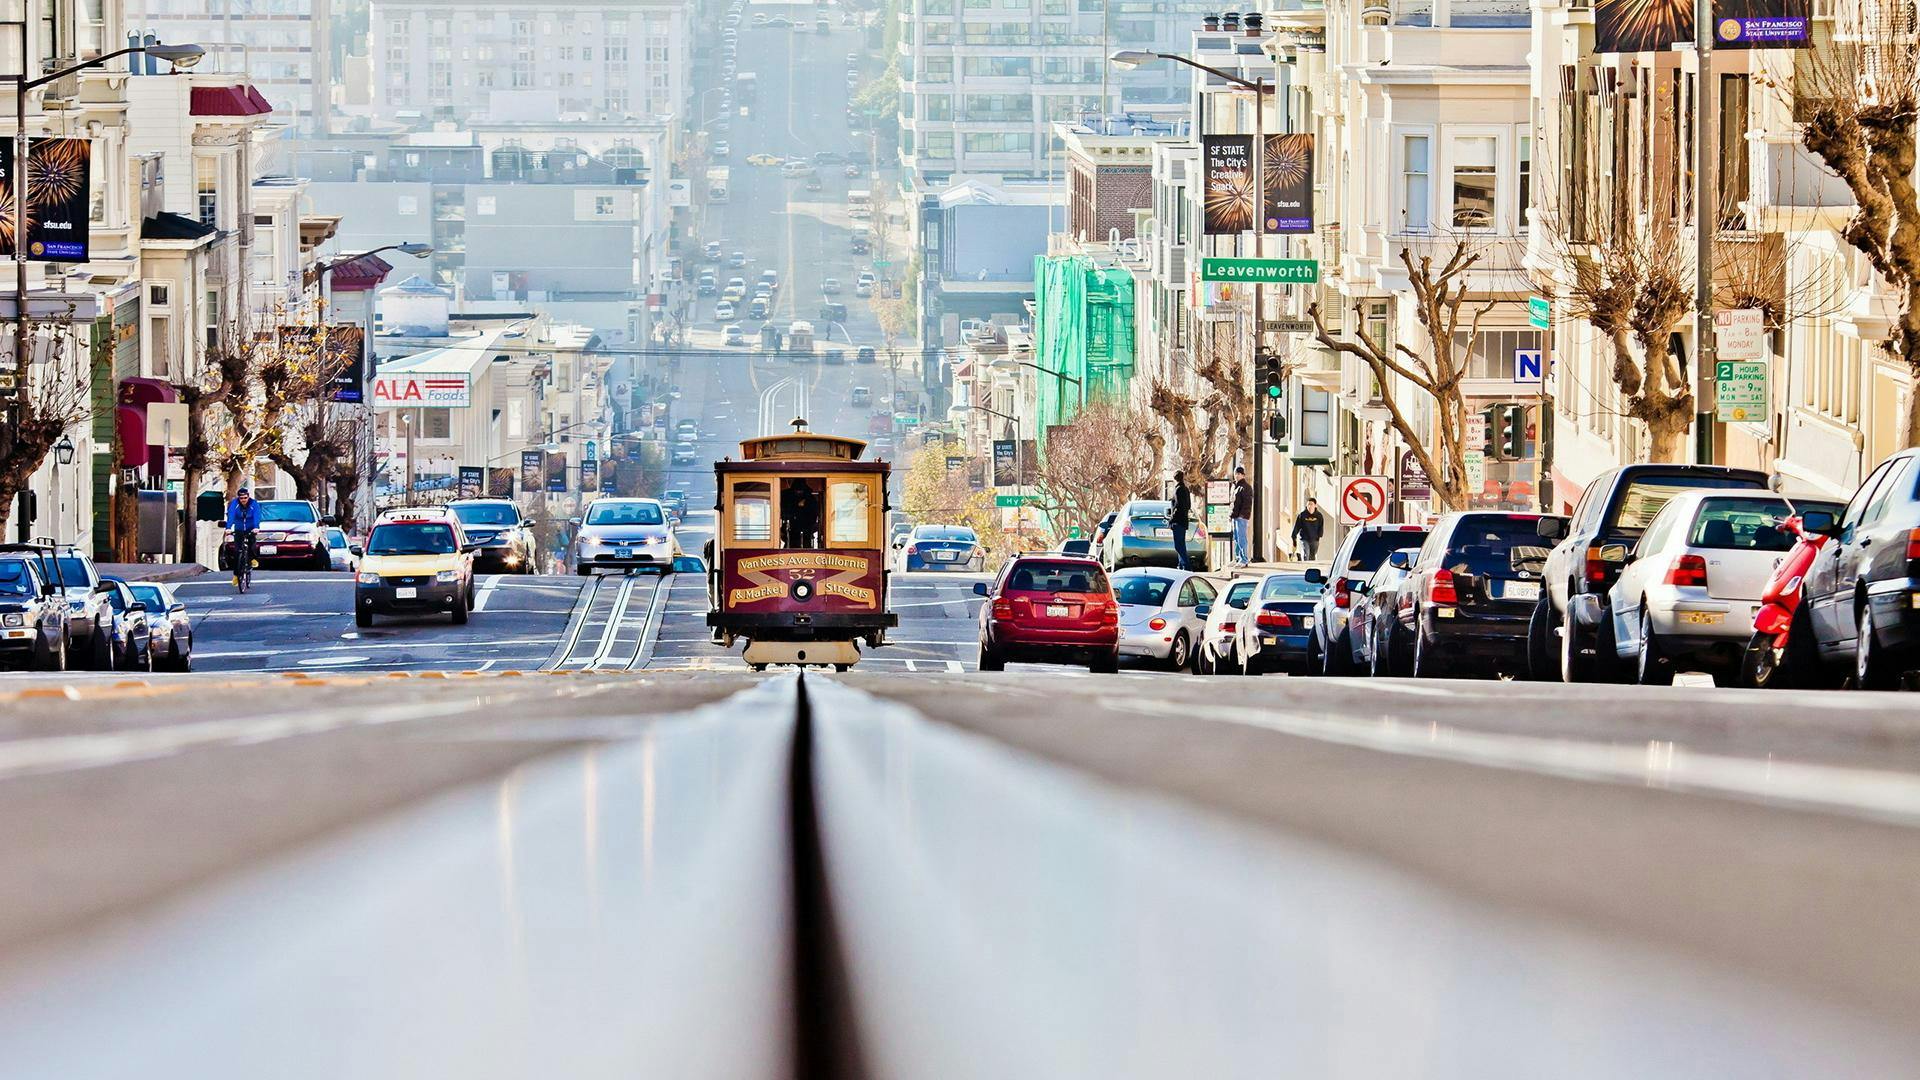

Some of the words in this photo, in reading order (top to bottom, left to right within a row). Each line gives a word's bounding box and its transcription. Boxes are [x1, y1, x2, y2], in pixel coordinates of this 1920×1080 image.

[1762, 20, 1802, 28] FRANCISCO
[1211, 145, 1220, 155] SF
[1222, 145, 1245, 155] STATE
[1211, 157, 1225, 167] The
[1226, 157, 1248, 168] City's
[1211, 170, 1244, 179] Creative
[1277, 200, 1300, 208] sfsu.edu
[43, 219, 72, 230] sfsu.edu
[1207, 263, 1312, 278] Leavenworth
[1718, 311, 1731, 326] NO
[1733, 314, 1760, 324] PARKING
[1266, 322, 1312, 331] LEAVENWORTH
[1727, 340, 1754, 349] MONDAY
[1720, 365, 1730, 378] 2
[1734, 373, 1765, 381] PARKING
[374, 379, 422, 401] ALA
[428, 389, 465, 400] Foods
[1466, 417, 1483, 425] ARKING
[1006, 498, 1023, 506] Hy
[1208, 506, 1213, 514] 2
[740, 560, 759, 570] Van
[759, 556, 785, 568] Ness
[815, 555, 867, 570] California
[789, 568, 816, 581] 52
[735, 590, 743, 600] &
[744, 585, 784, 600] Market
[825, 582, 868, 599] Streets
